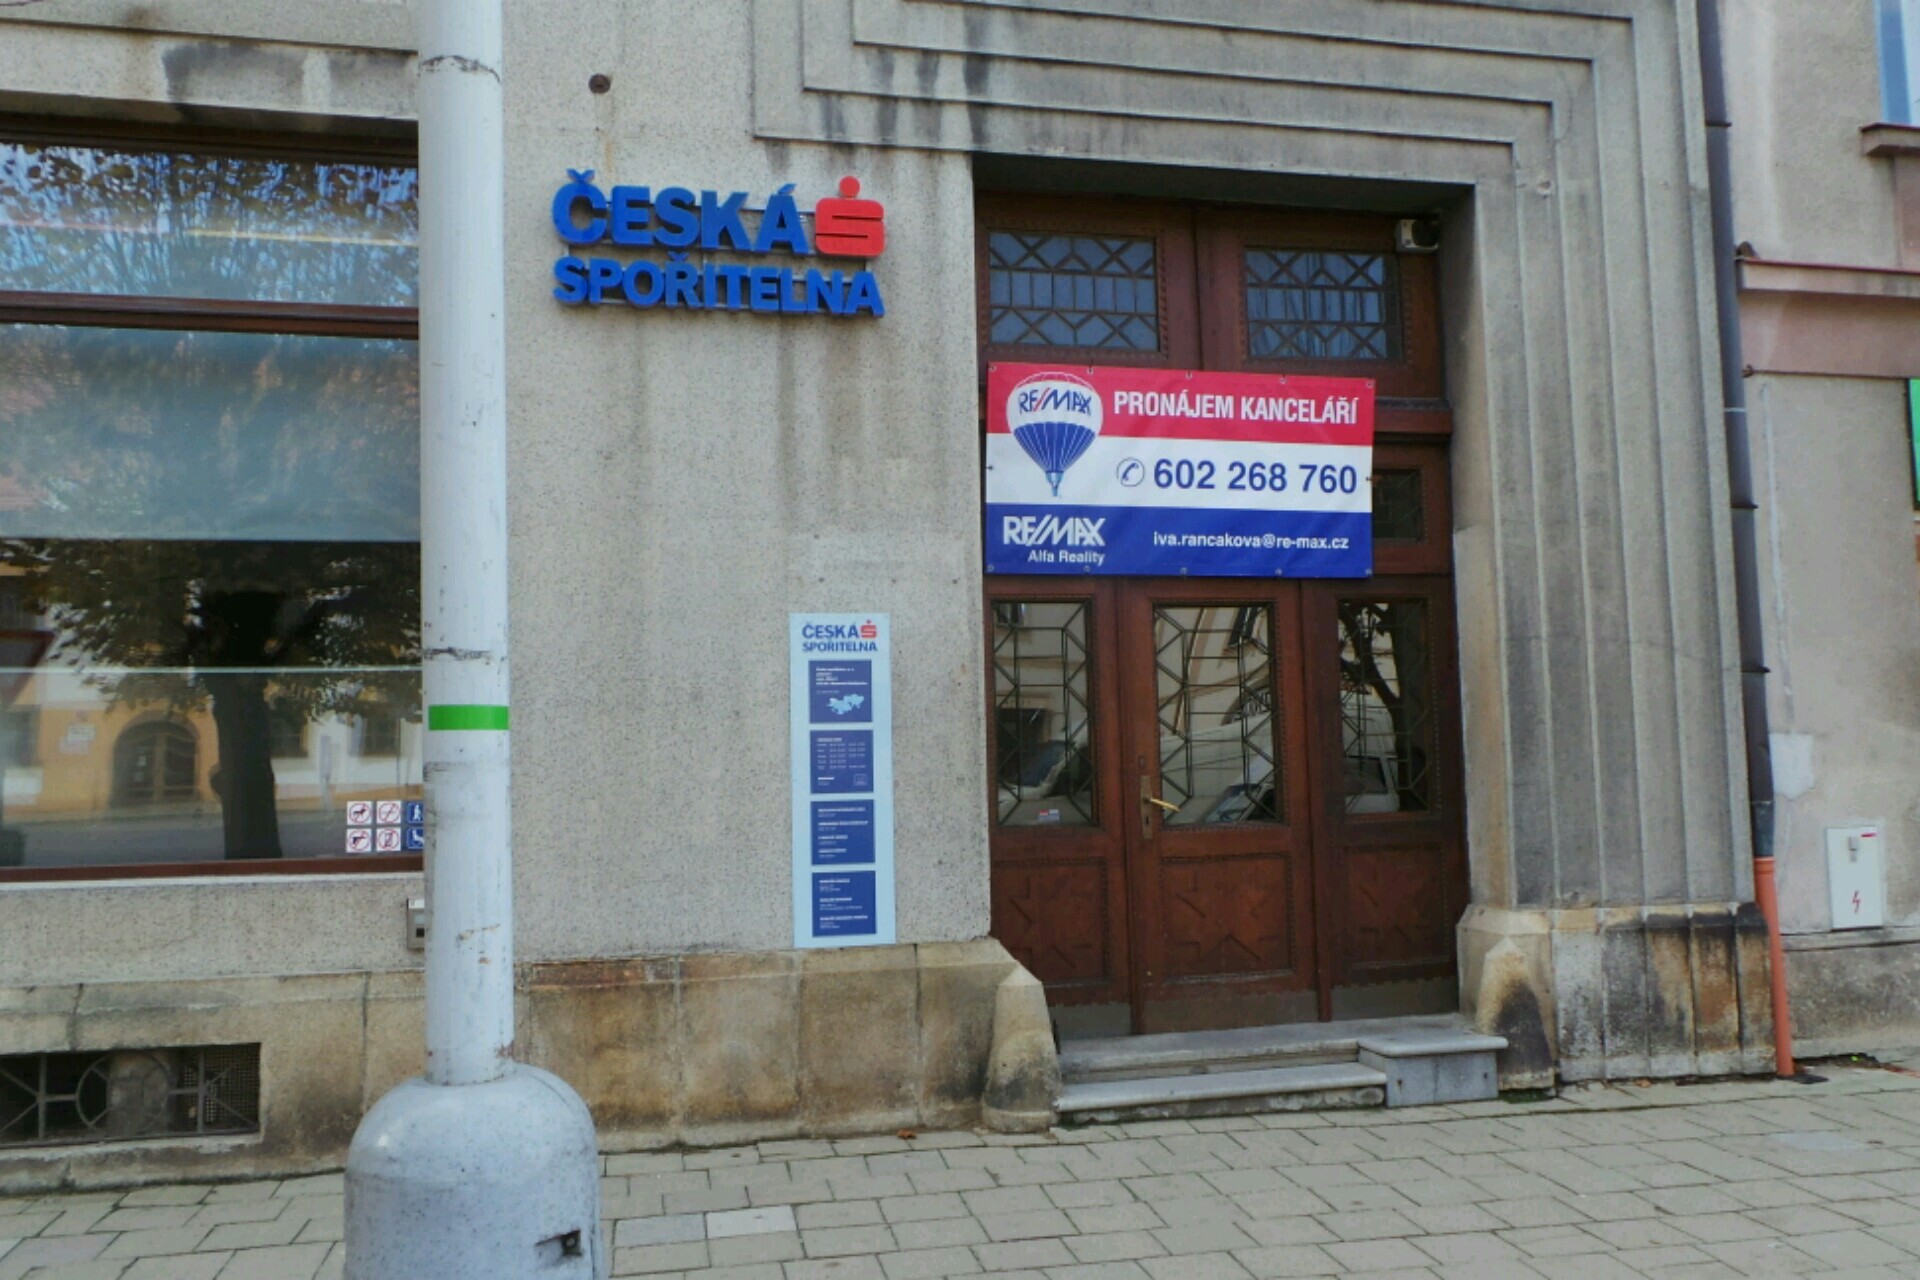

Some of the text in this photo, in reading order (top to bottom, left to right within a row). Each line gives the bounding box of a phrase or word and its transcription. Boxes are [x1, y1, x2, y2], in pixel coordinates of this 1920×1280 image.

[552, 168, 810, 255] ČESKÁ
[552, 251, 886, 317] SPOŘITELNA
[1018, 387, 1092, 414] RE/MAX
[1114, 390, 1359, 424] PRONÁJEM KANCELÁŘÍ
[1154, 459, 1357, 493] 602 268 760
[1003, 514, 1106, 547] RE/MAX
[1153, 531, 1349, 549] iva.rancakova@re-max.cz
[1027, 549, 1106, 567] Alfa Reality
[802, 621, 859, 639] ČESKÁ
[802, 640, 878, 652] SPOŘITELNA
